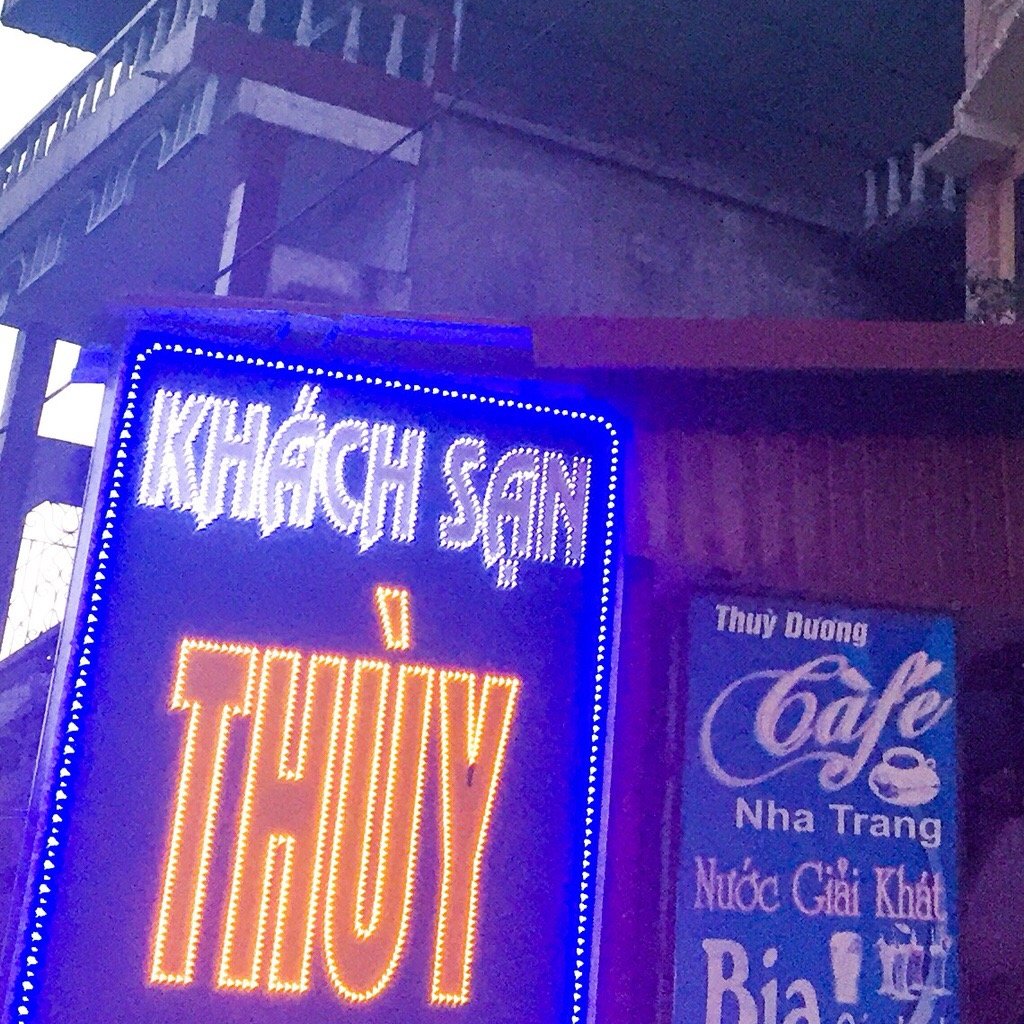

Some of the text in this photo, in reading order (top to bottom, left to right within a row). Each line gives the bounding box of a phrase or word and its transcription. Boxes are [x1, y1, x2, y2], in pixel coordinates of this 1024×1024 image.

[138, 384, 592, 588] KHÁCH SẠN
[147, 586, 521, 1006] THÙY
[735, 797, 942, 848] Nha Trang
[693, 856, 780, 912] Nước
[792, 857, 861, 916] Giải
[702, 938, 822, 1024] Bia
